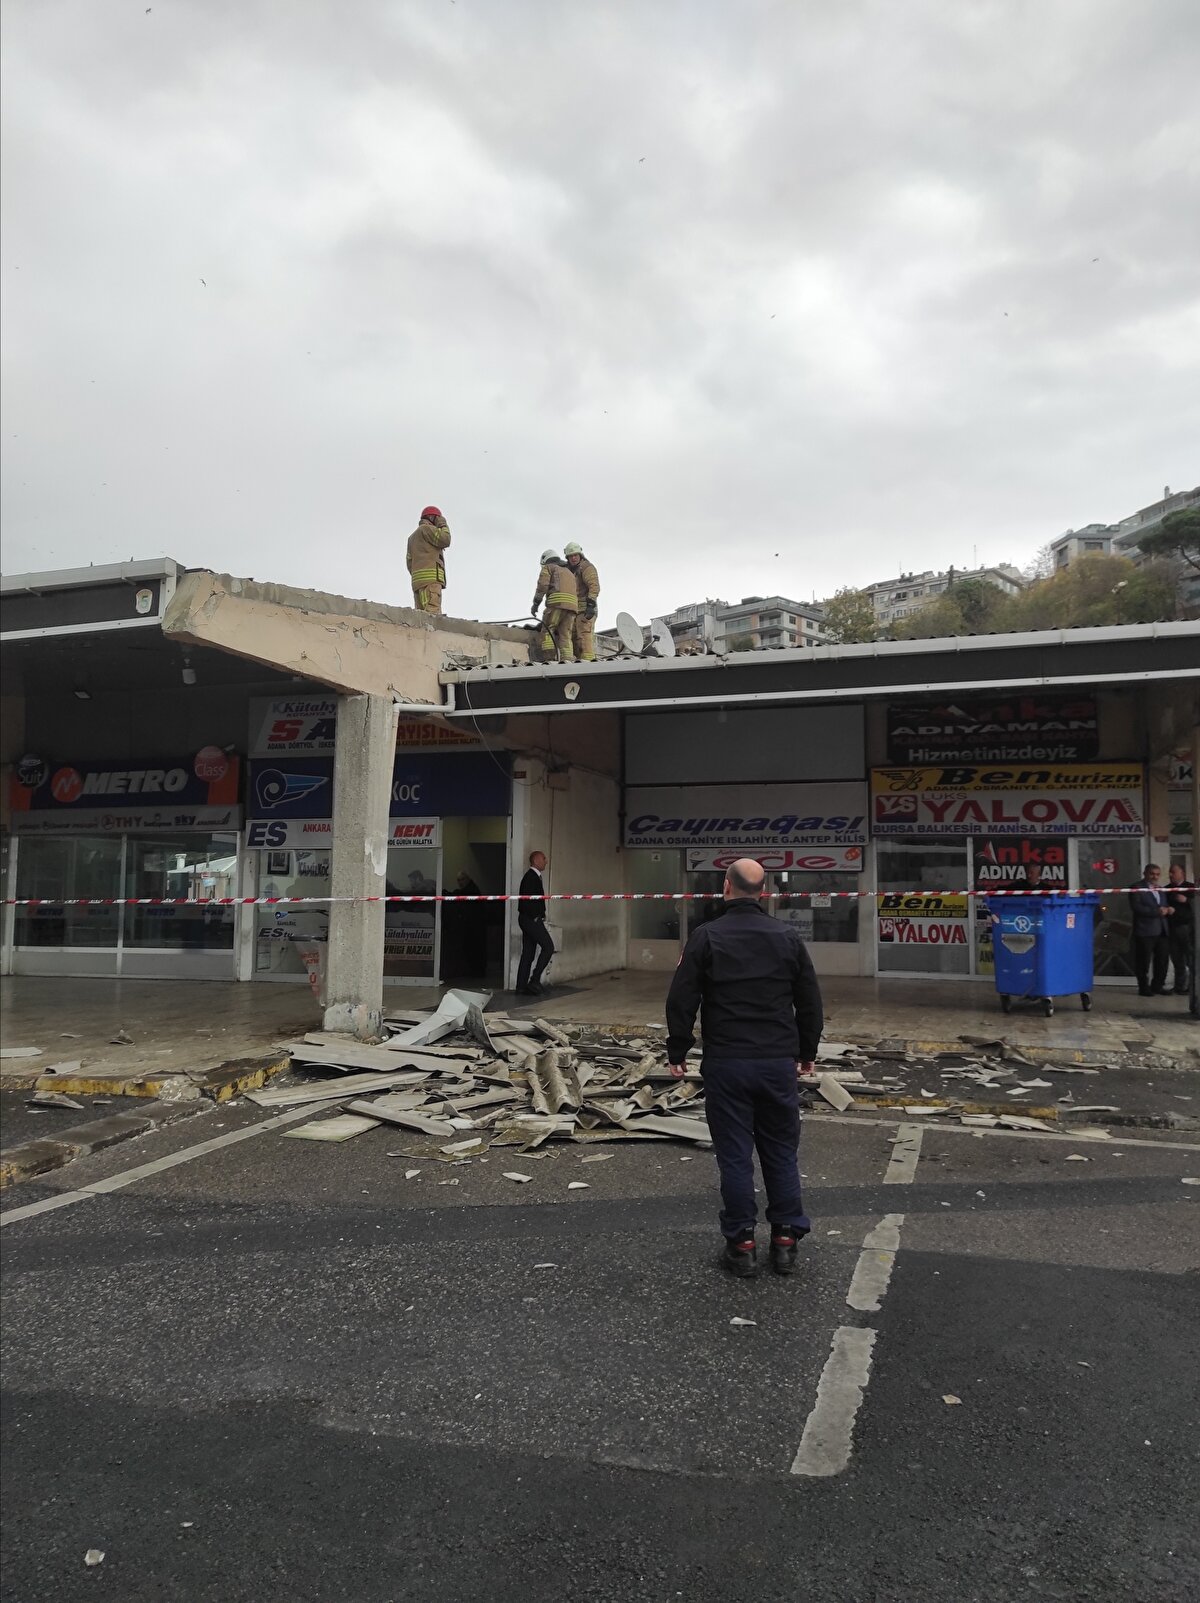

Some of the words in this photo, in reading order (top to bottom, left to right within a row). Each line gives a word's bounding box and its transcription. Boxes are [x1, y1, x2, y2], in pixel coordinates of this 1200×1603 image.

[569, 686, 575, 696] 4
[890, 719, 1096, 736] ADIYAMAN
[908, 744, 1078, 763] Hizmetinizdeyiz
[19, 767, 42, 784] Suit
[195, 763, 224, 778] Class
[937, 767, 1051, 786] Ben
[1054, 772, 1141, 784] turizm
[82, 768, 189, 795] METRO
[921, 799, 1134, 823] YALOVA
[114, 815, 142, 828] THY
[873, 824, 914, 833] BURSA
[917, 823, 982, 833] BALIKESİR
[987, 823, 1037, 833] MANİSA
[1041, 823, 1077, 833] İZMİR
[1081, 822, 1143, 833] KÜTAHYA
[247, 821, 288, 847] ES
[302, 823, 331, 833] ANKARA
[393, 824, 434, 838] KENT
[628, 837, 664, 845] ADANA
[667, 835, 724, 844] OSMANİYE
[781, 835, 831, 844] G.ANTEP
[834, 834, 866, 843] KİLİS
[978, 865, 1065, 880] ADIYAAN
[1103, 862, 1114, 874] 3
[880, 895, 943, 909] Ben
[895, 924, 965, 944] YALOVA
